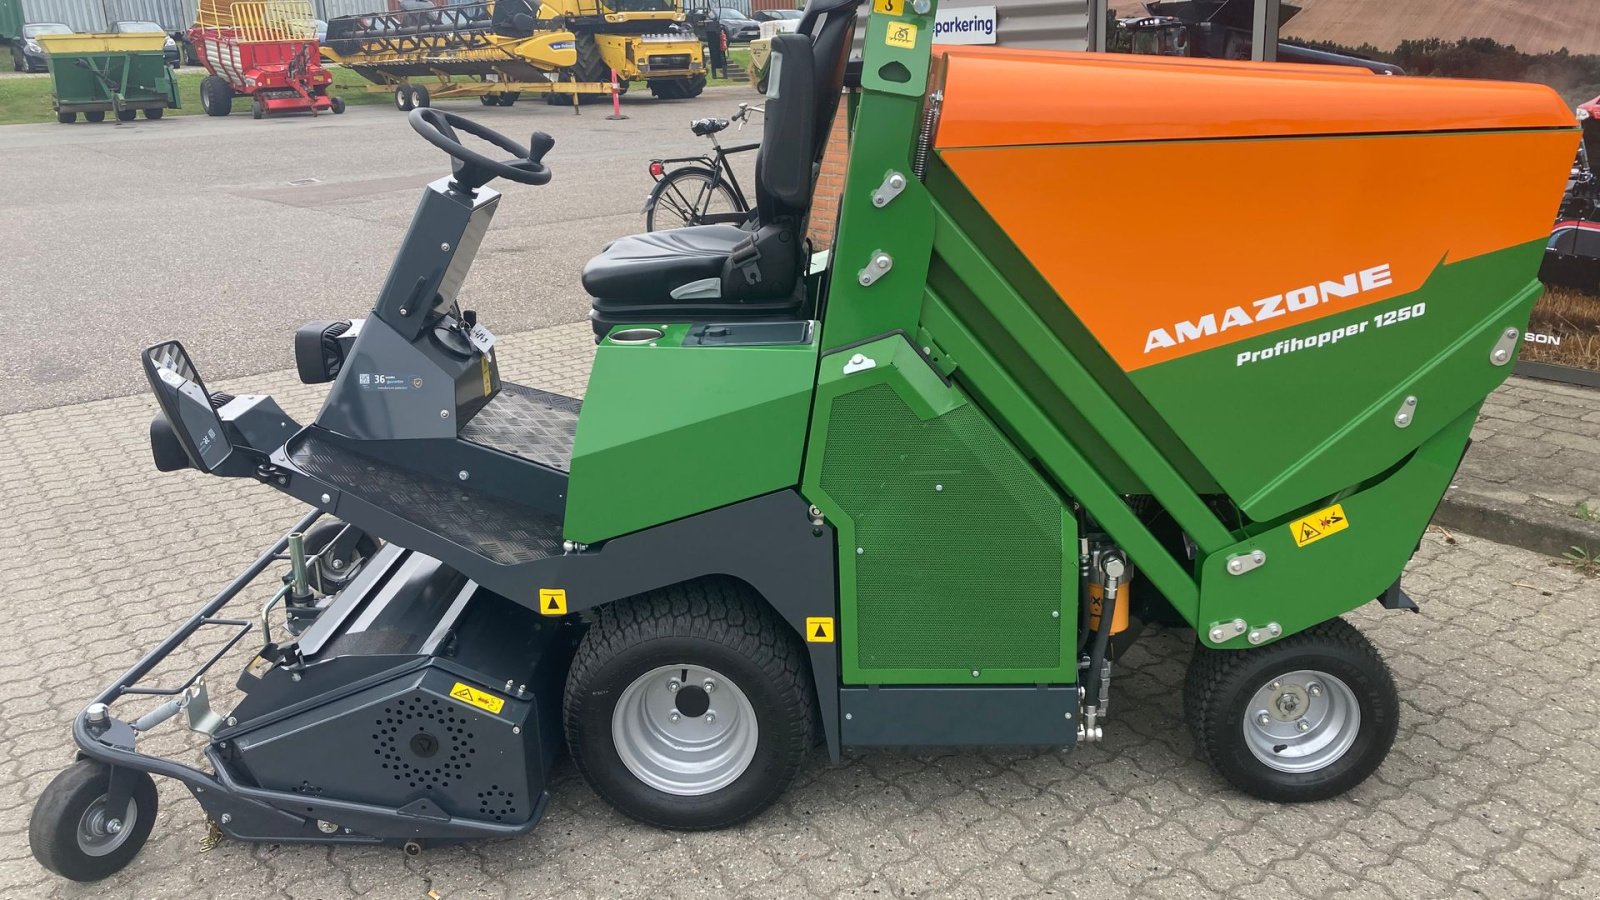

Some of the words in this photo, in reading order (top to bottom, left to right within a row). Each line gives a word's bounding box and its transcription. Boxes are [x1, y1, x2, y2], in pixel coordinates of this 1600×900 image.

[933, 15, 993, 37] parkering
[1144, 264, 1392, 353] AMAZONE
[1236, 321, 1368, 366] Profihopper
[1374, 302, 1426, 328] 1250
[374, 374, 385, 384] 36
